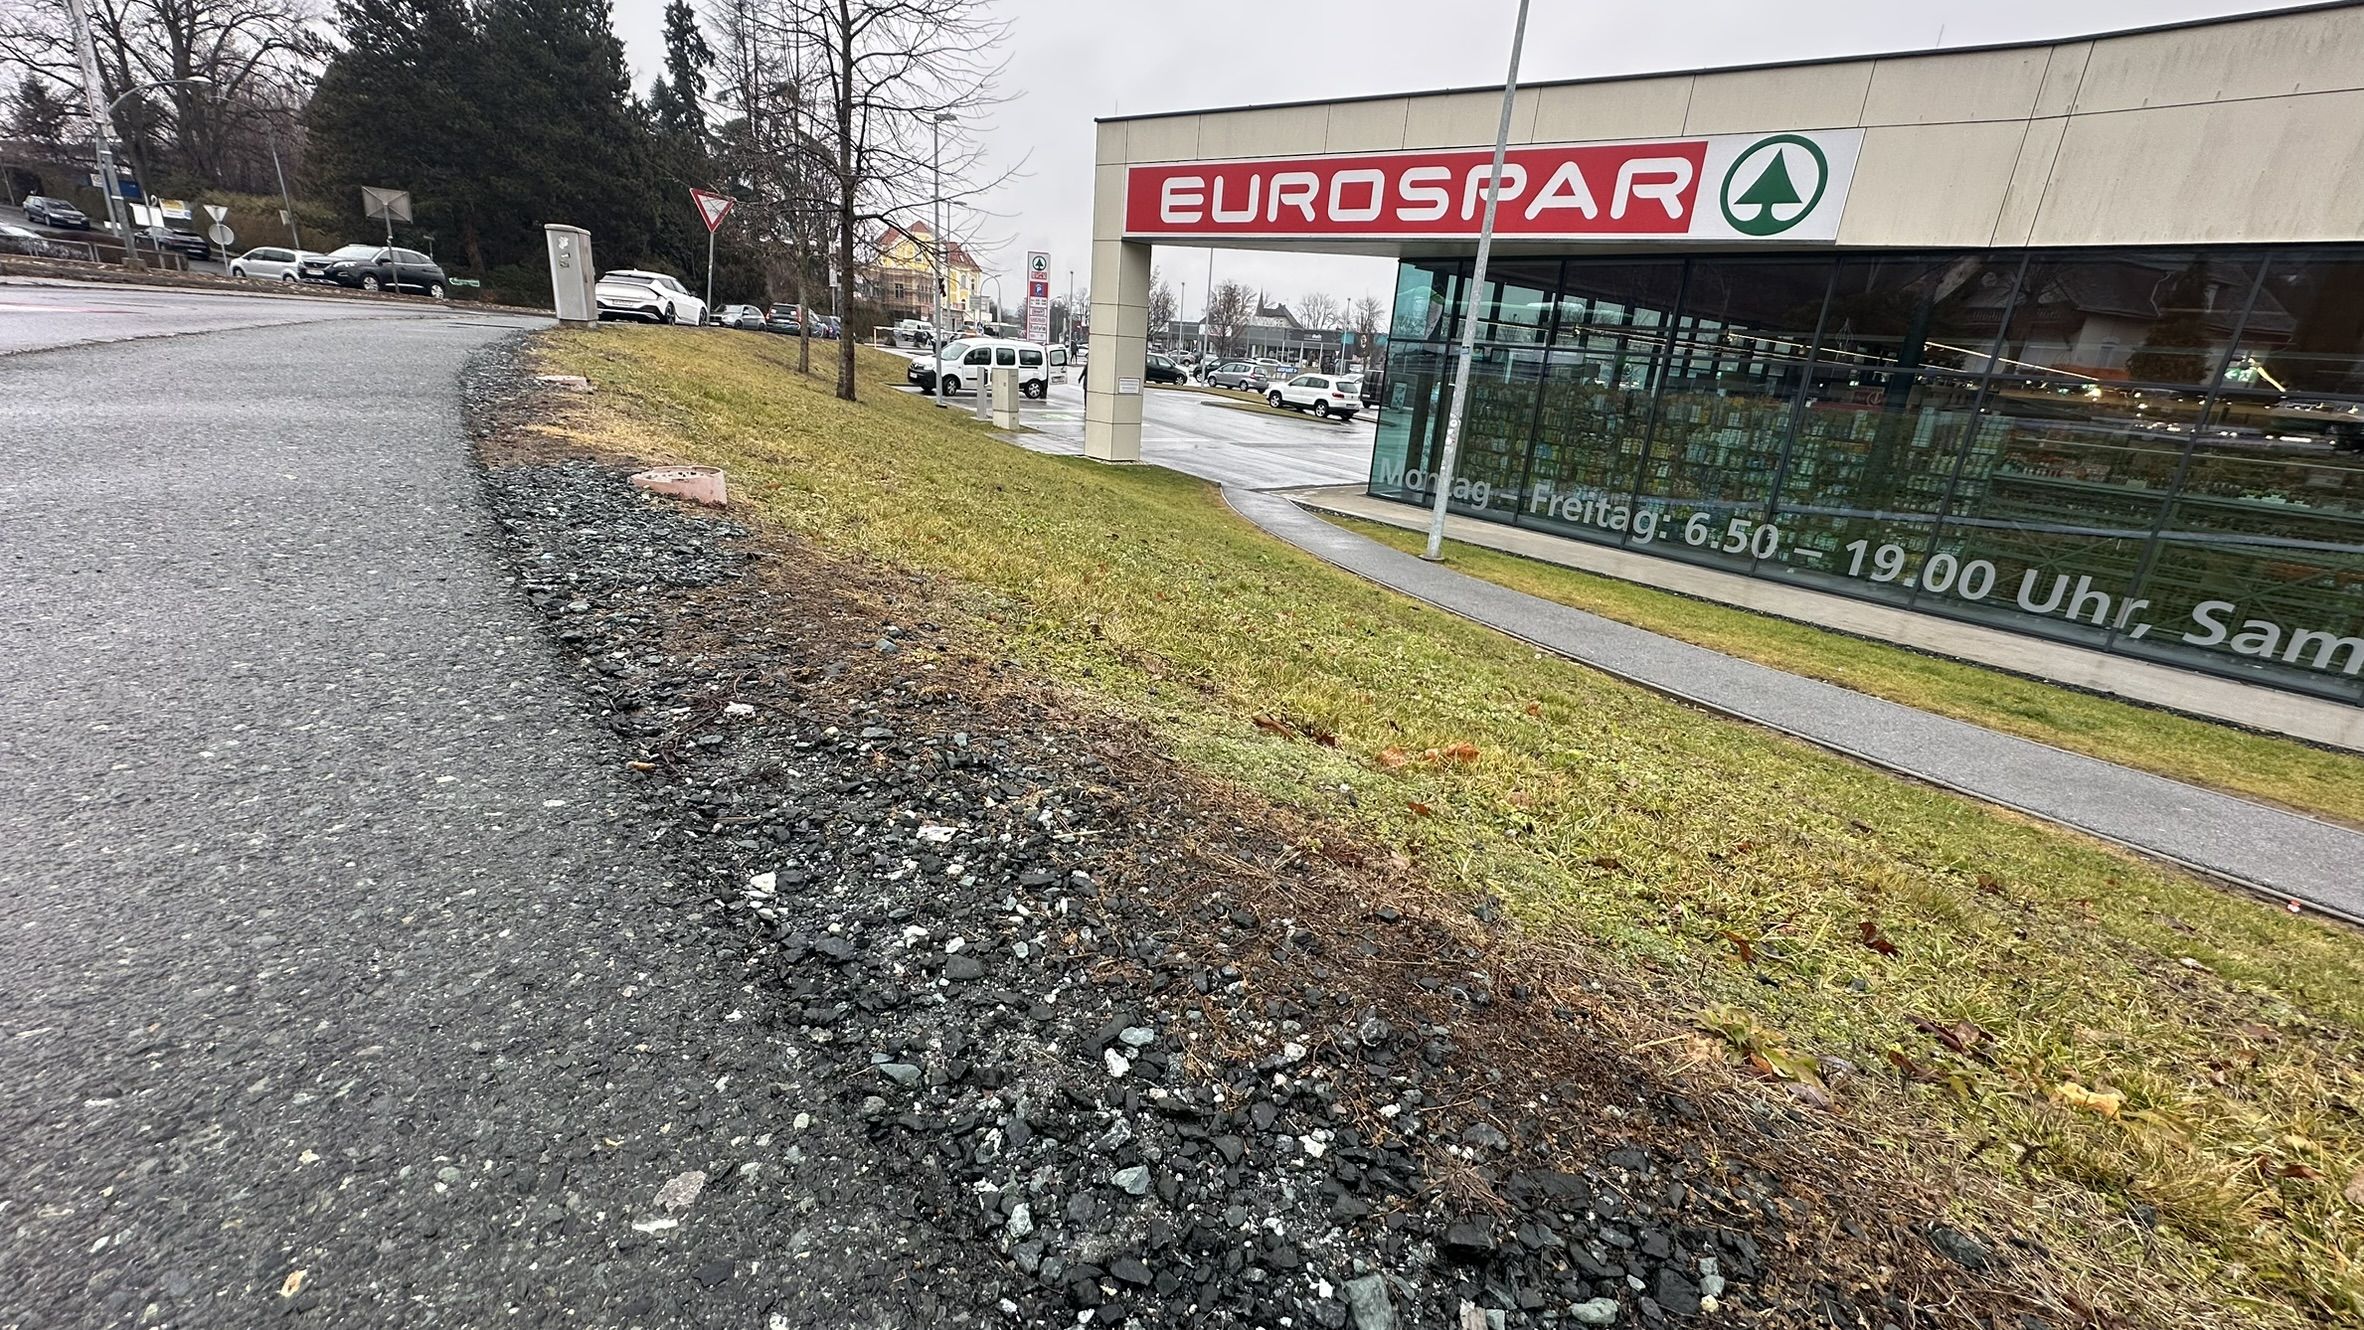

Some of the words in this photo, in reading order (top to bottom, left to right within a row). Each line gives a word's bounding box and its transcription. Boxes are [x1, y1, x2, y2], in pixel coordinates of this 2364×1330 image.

[1159, 156, 1693, 224] EUROSPAR
[1378, 457, 1491, 511] Monag
[1529, 483, 1671, 544] Freitag:
[1684, 510, 1780, 560] 6.50
[1845, 539, 1997, 601] 19.00
[2015, 567, 2153, 640] Uhr,
[2182, 600, 2364, 675] Sam
